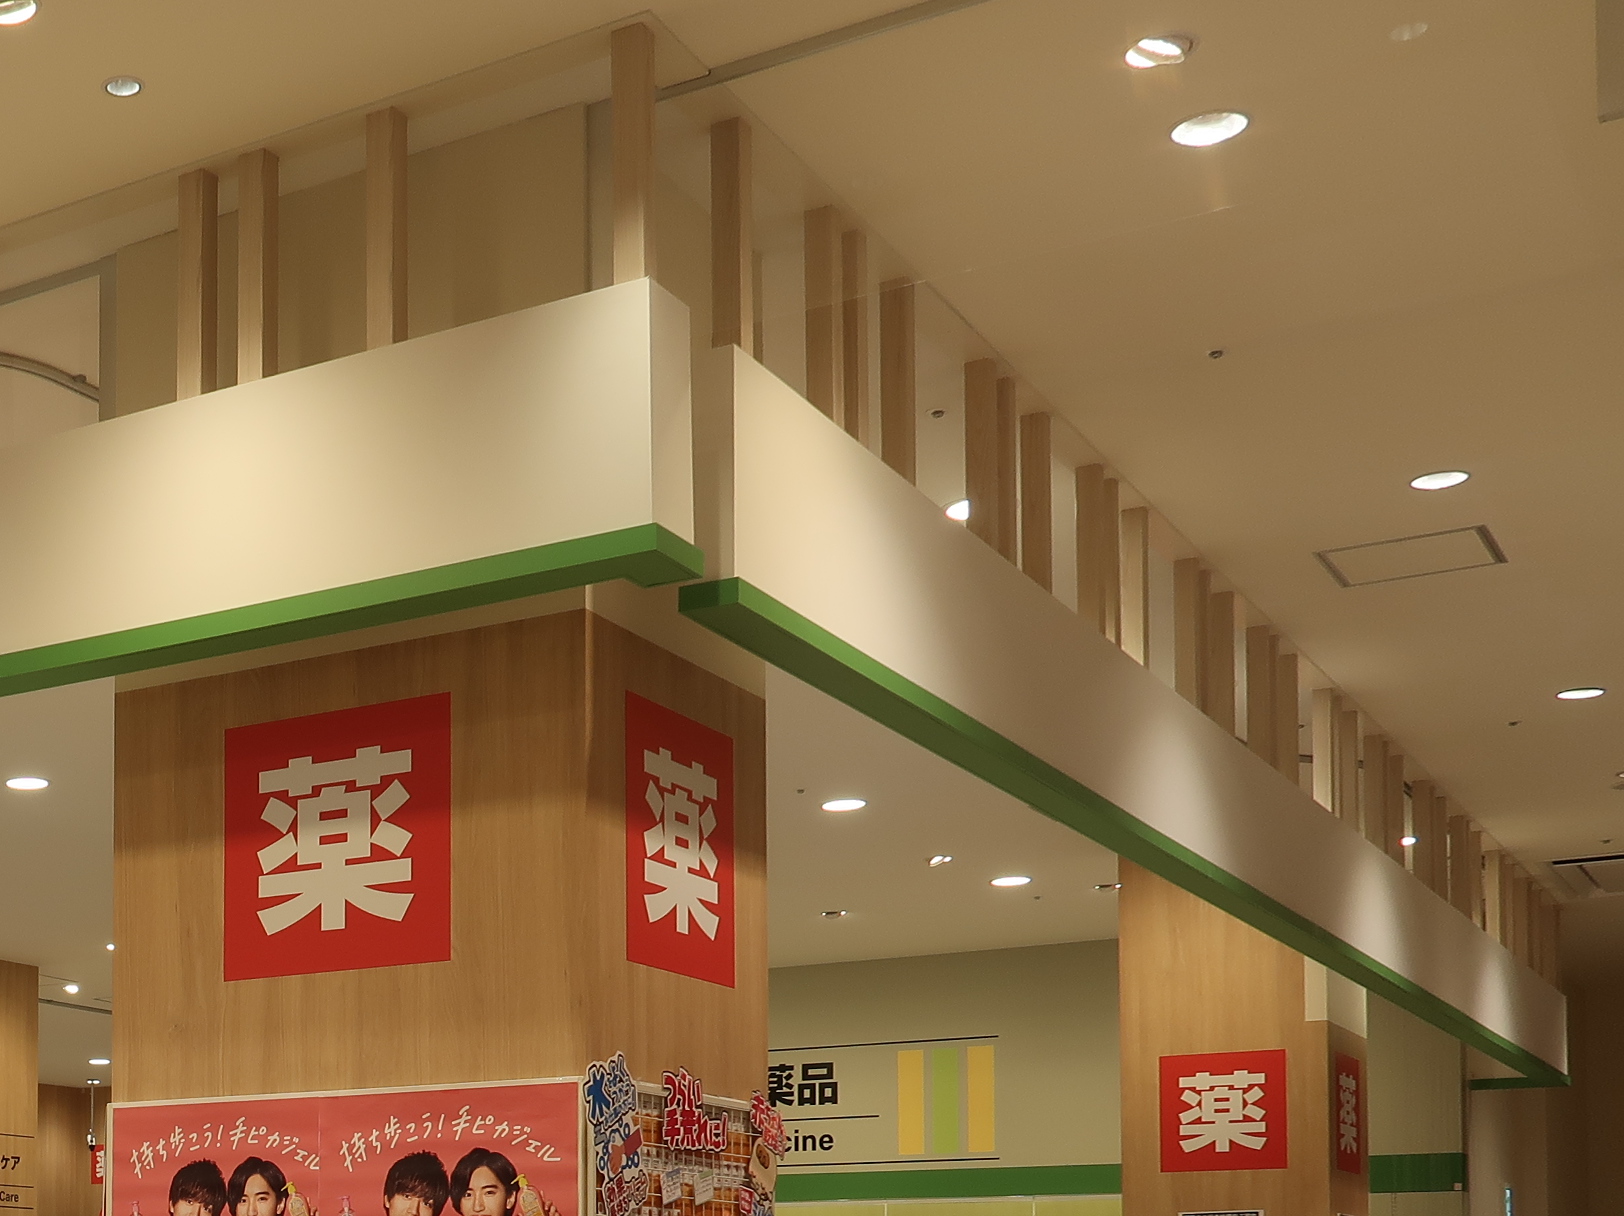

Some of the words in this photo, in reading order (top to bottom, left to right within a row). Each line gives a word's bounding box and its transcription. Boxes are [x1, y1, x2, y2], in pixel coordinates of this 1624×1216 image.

[256, 745, 415, 936] 薬
[643, 746, 720, 941] 薬
[784, 1129, 834, 1152] cine
[1178, 1070, 1267, 1152] 薬
[1338, 1073, 1358, 1153] 薬
[0, 1191, 19, 1203] Care
